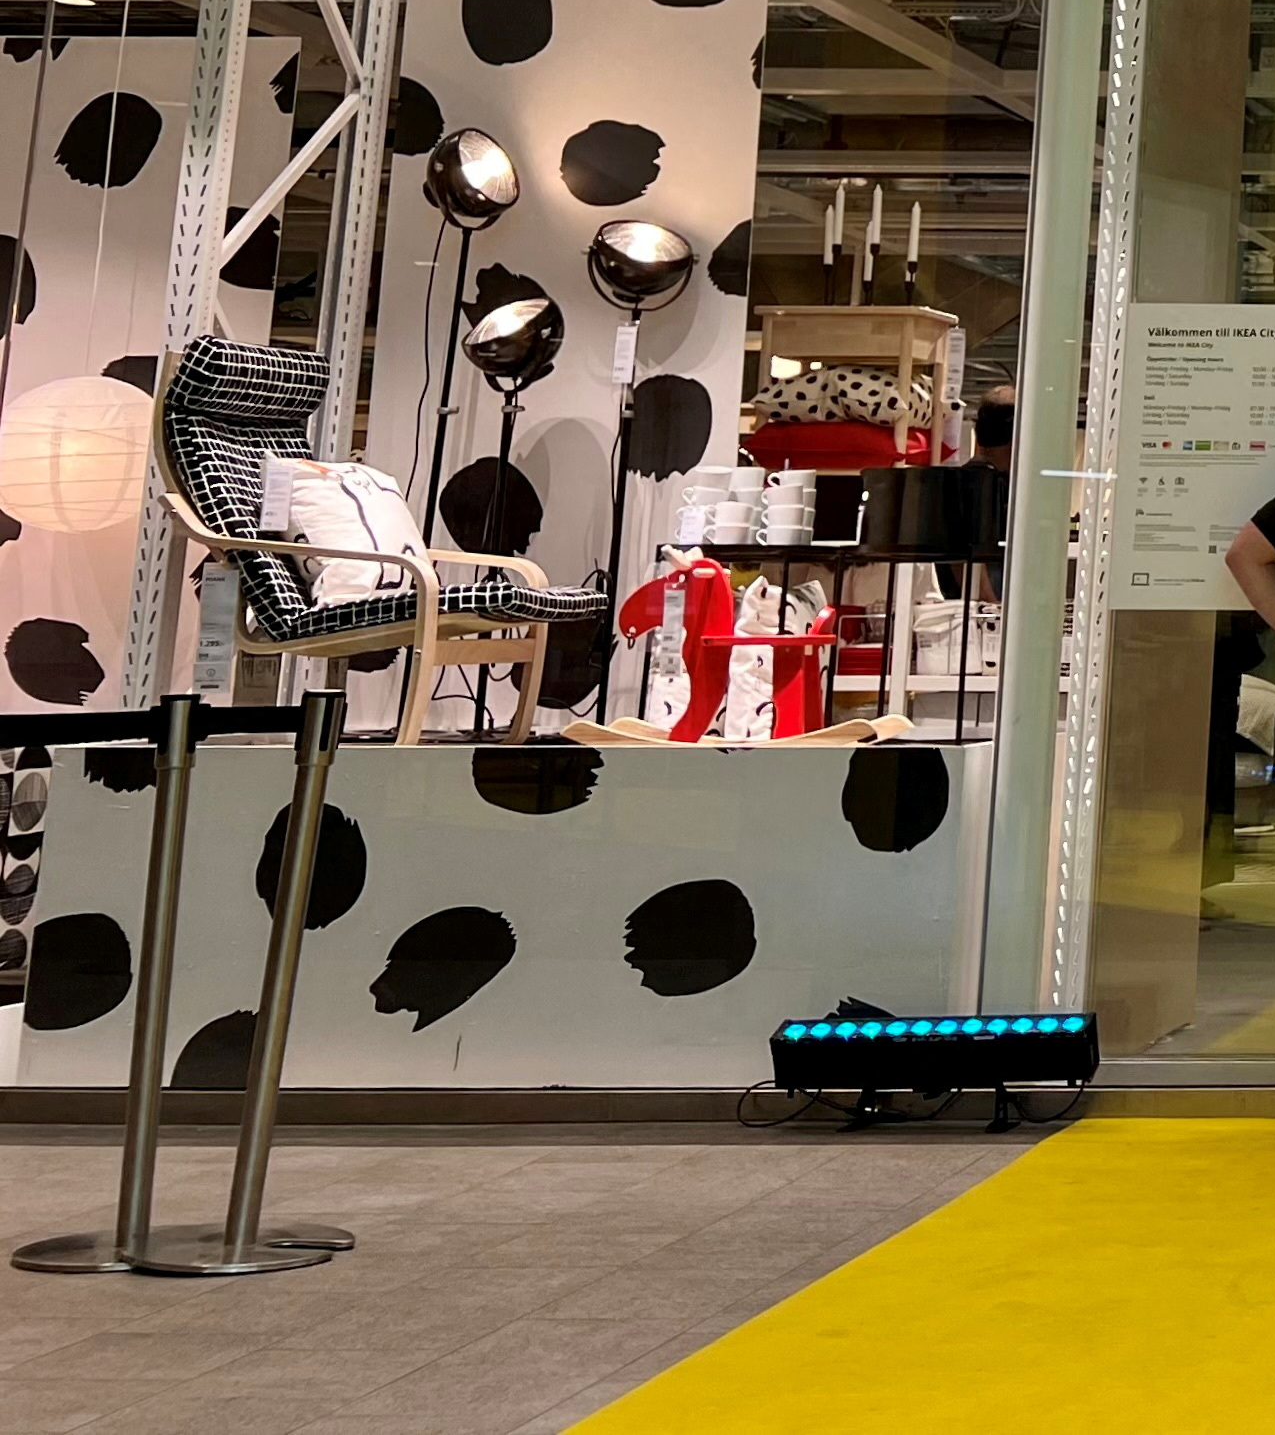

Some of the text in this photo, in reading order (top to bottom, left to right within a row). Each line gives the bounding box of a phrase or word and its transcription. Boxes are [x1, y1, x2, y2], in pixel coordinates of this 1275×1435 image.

[1148, 327, 1213, 338] Välkommen
[1215, 327, 1230, 338] till
[1232, 328, 1257, 338] IKEA
